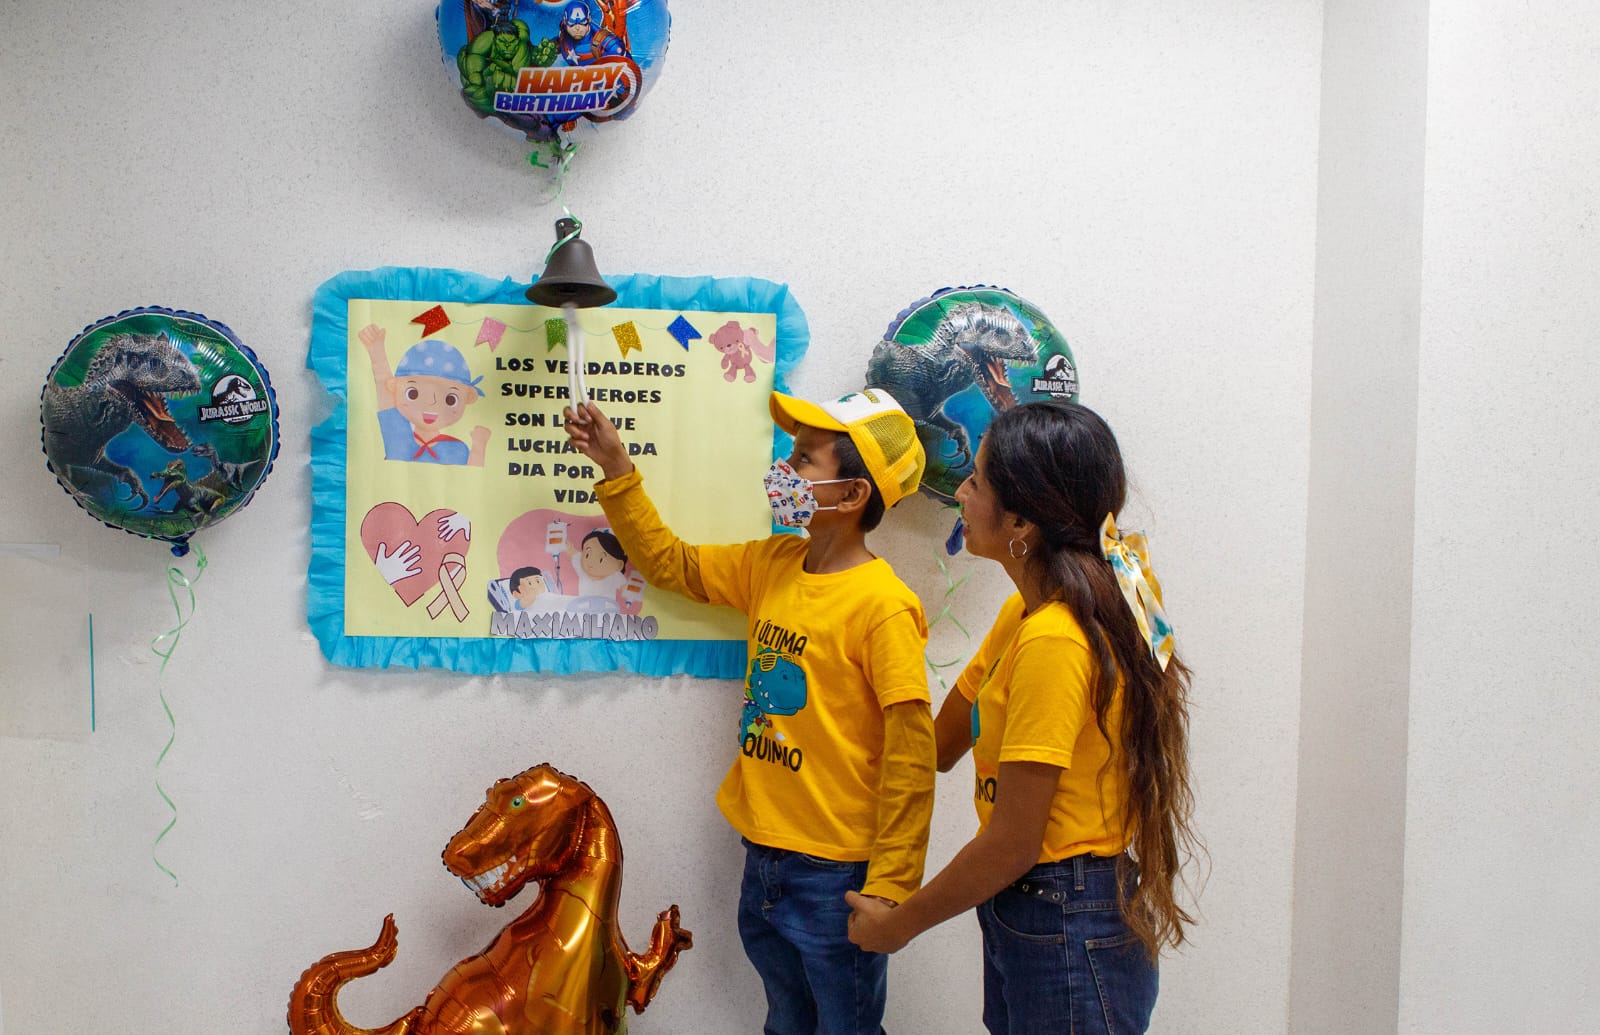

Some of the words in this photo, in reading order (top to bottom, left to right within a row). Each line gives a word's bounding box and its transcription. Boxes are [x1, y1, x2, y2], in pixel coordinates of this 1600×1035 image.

[517, 65, 623, 93] HAPPY
[495, 92, 613, 112] BIRTHDAY
[495, 357, 534, 372] LOS
[501, 383, 570, 399] SUPER
[1033, 379, 1063, 392] JURASSIC
[201, 404, 239, 421] JURASSIC
[240, 400, 267, 415] WORLD
[505, 413, 545, 427] SON
[610, 417, 636, 431] UE
[508, 438, 584, 454] LUCHA
[508, 462, 546, 477] DIA
[553, 463, 595, 479] POR
[758, 619, 808, 657] ÚLTIMA
[742, 732, 803, 772] QUIMO
